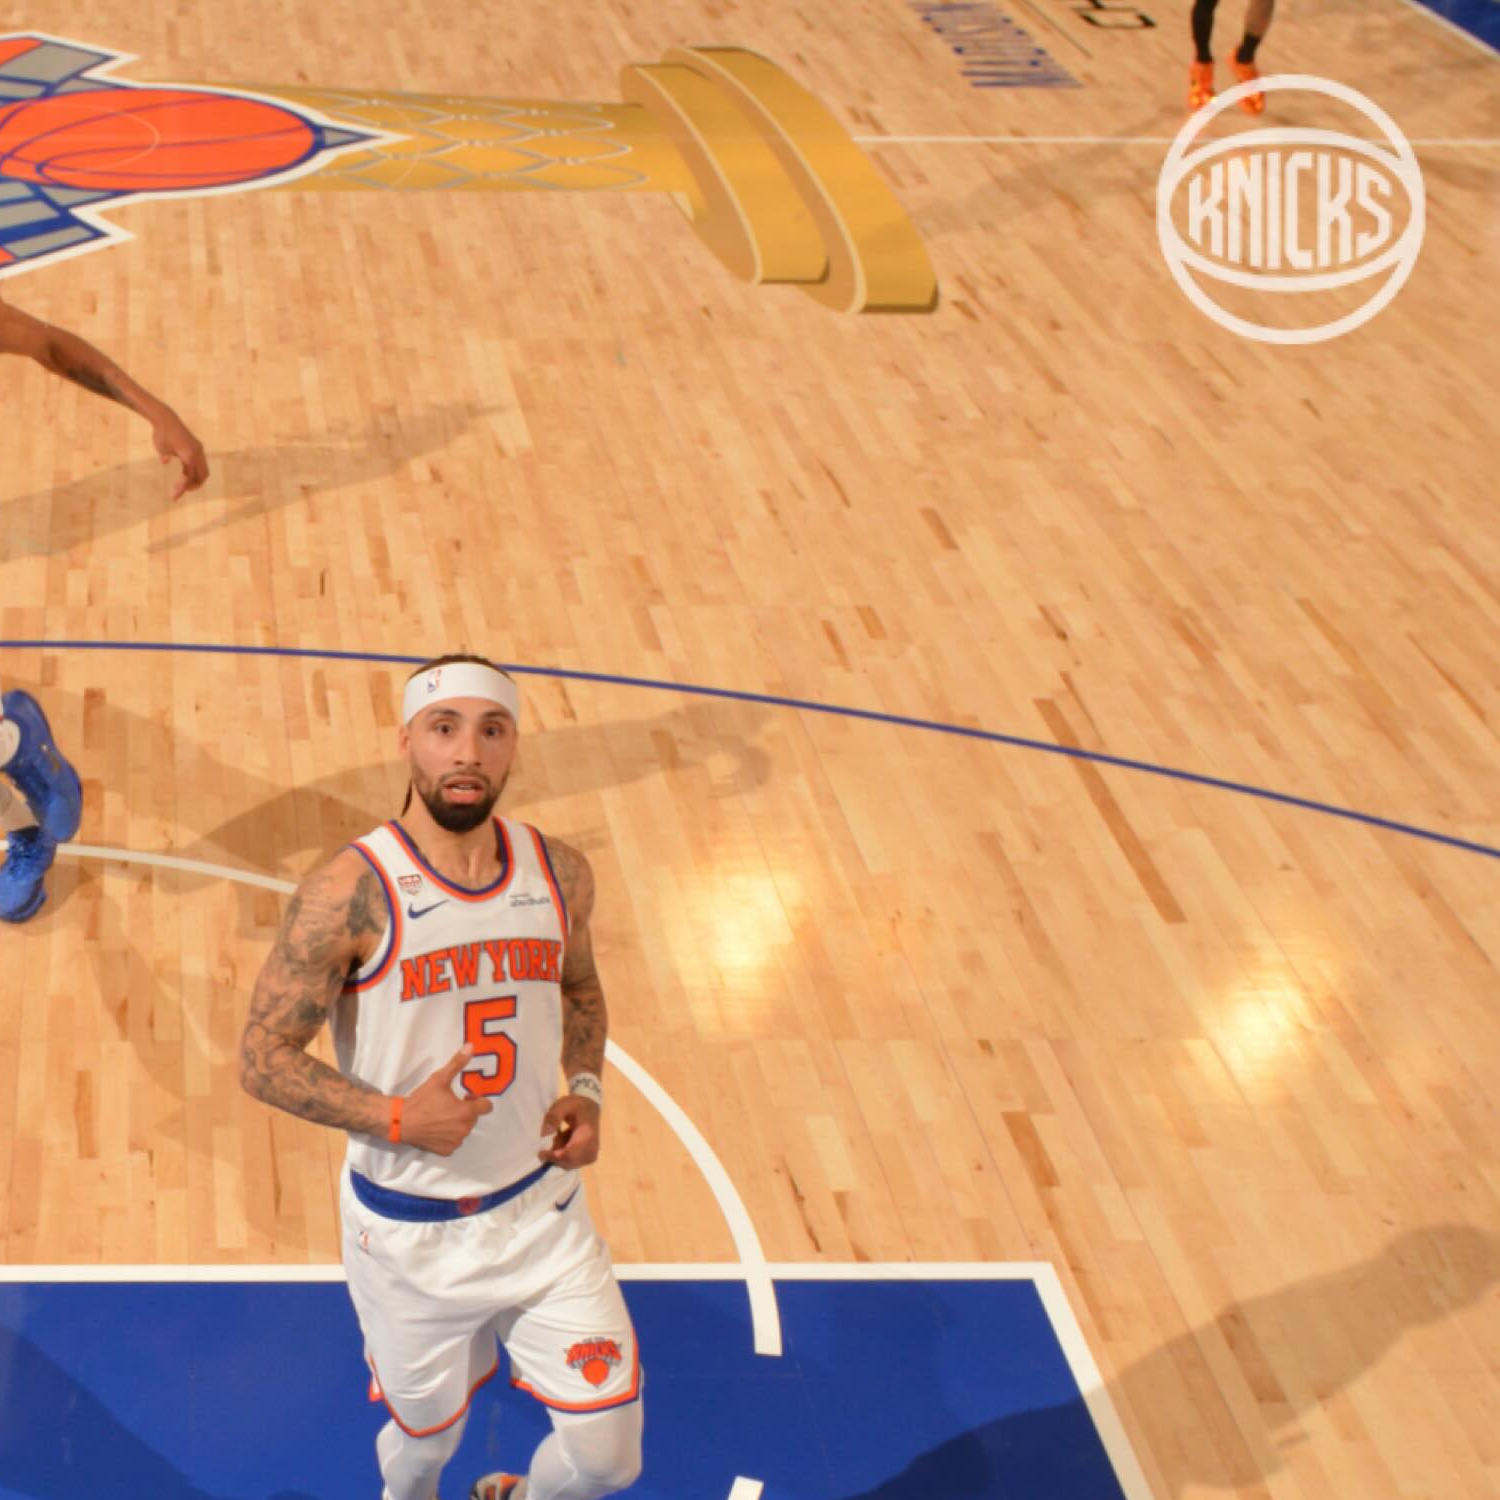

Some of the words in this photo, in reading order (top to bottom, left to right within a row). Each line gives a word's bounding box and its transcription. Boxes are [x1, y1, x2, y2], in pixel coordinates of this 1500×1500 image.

[400, 941, 487, 1003] NEW
[484, 937, 563, 985] YORK
[460, 995, 518, 1099] 5
